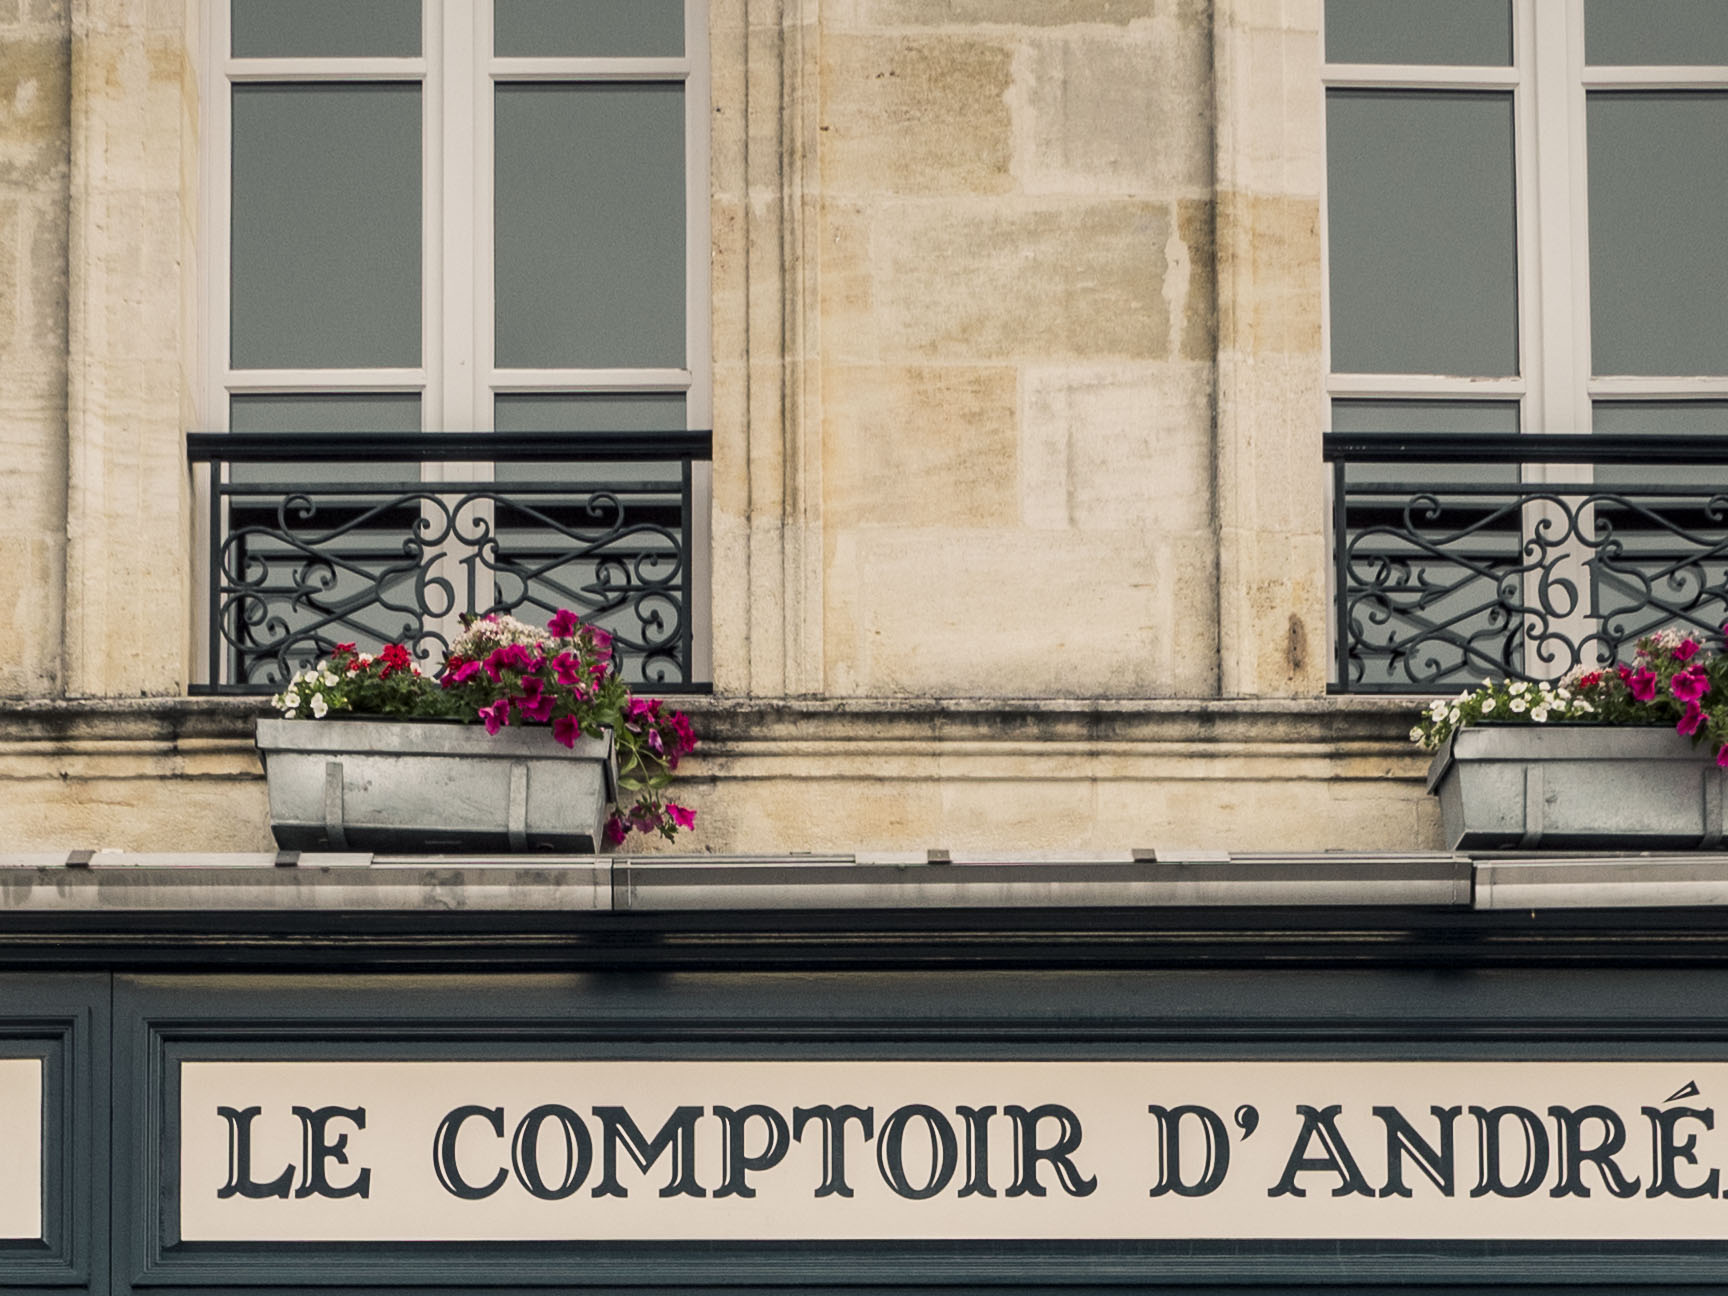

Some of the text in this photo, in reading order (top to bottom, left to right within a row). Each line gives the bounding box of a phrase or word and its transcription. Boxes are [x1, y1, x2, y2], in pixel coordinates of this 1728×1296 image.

[415, 552, 480, 619] 61
[1538, 553, 1608, 619] 61
[216, 1104, 372, 1200] LE
[432, 1103, 1098, 1201] COMPTOIR
